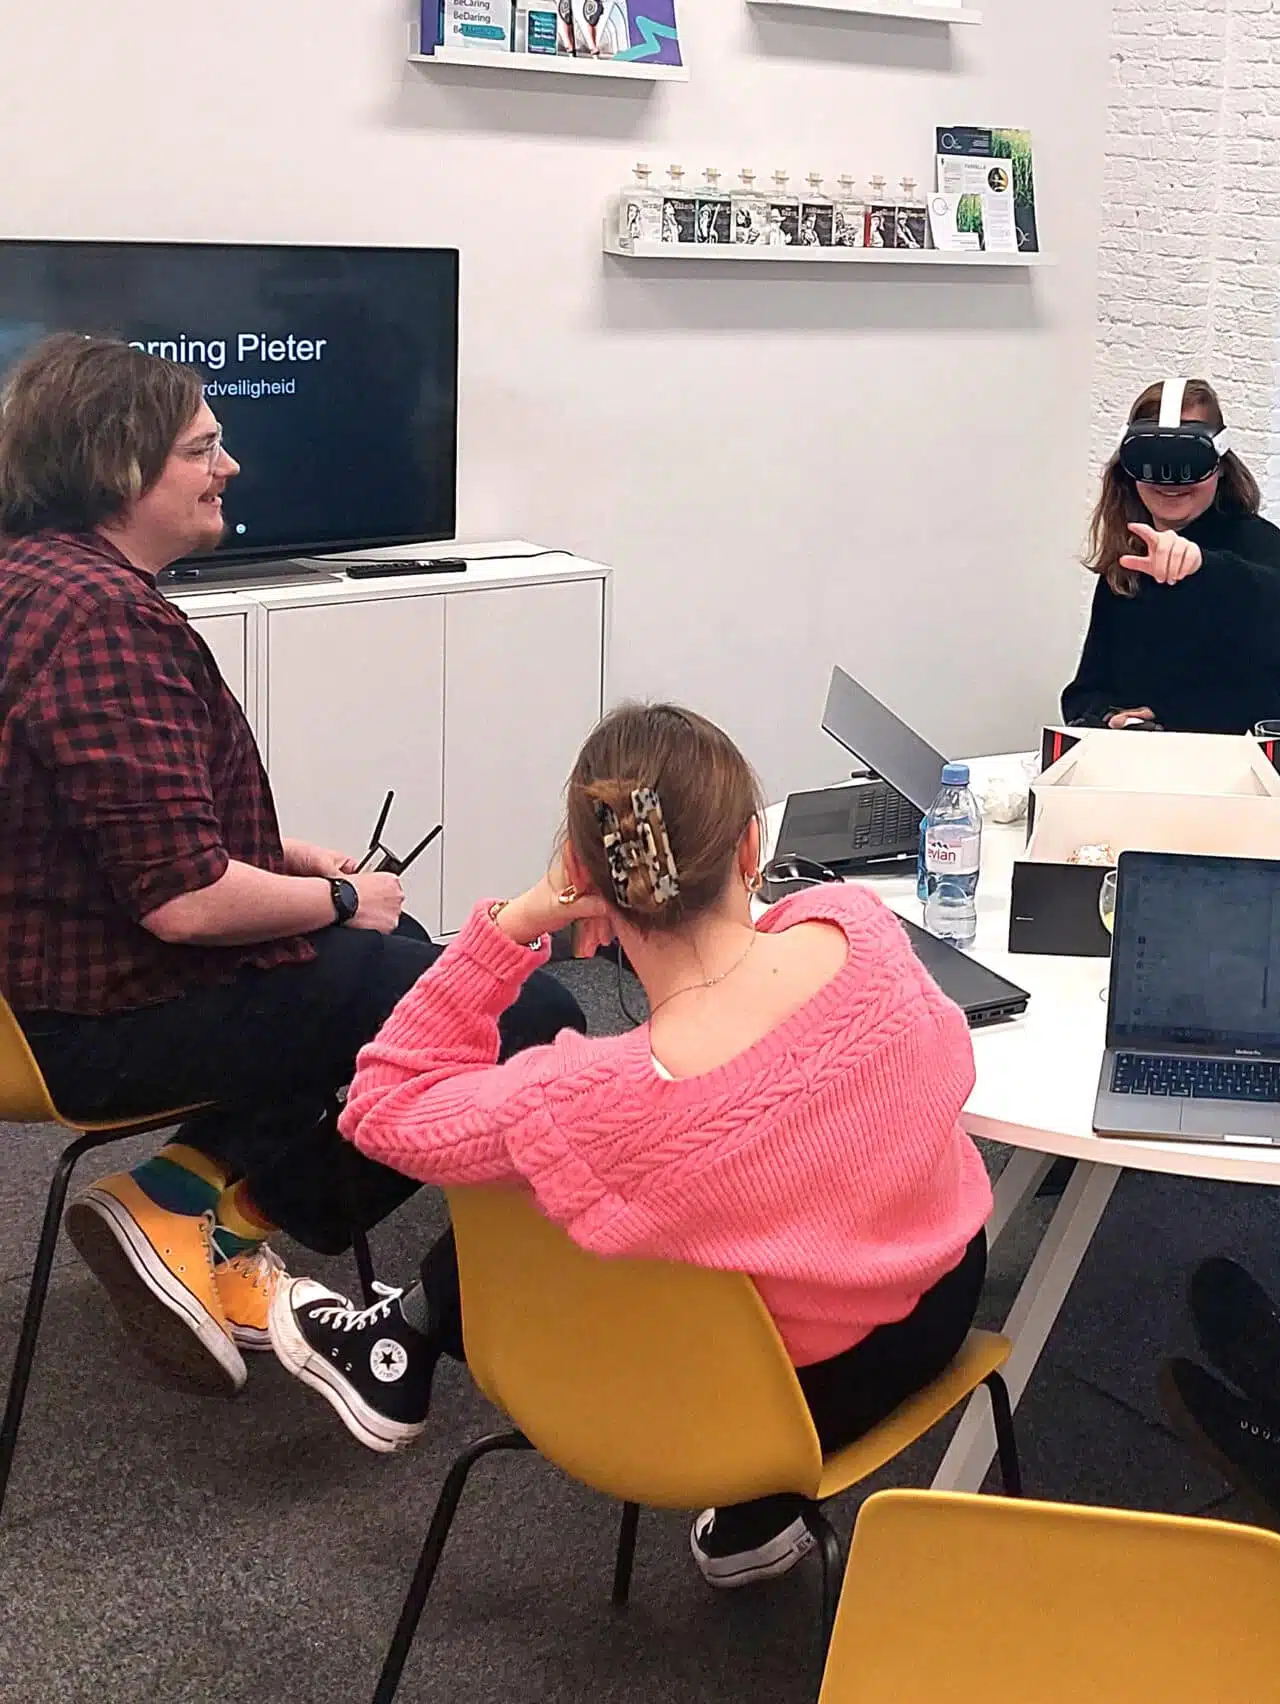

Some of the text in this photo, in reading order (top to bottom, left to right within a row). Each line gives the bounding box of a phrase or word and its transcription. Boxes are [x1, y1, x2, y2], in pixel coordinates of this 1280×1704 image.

[453, 11, 491, 24] BeDaring
[237, 333, 327, 362] Pieter
[201, 378, 296, 399] rdveiligheid
